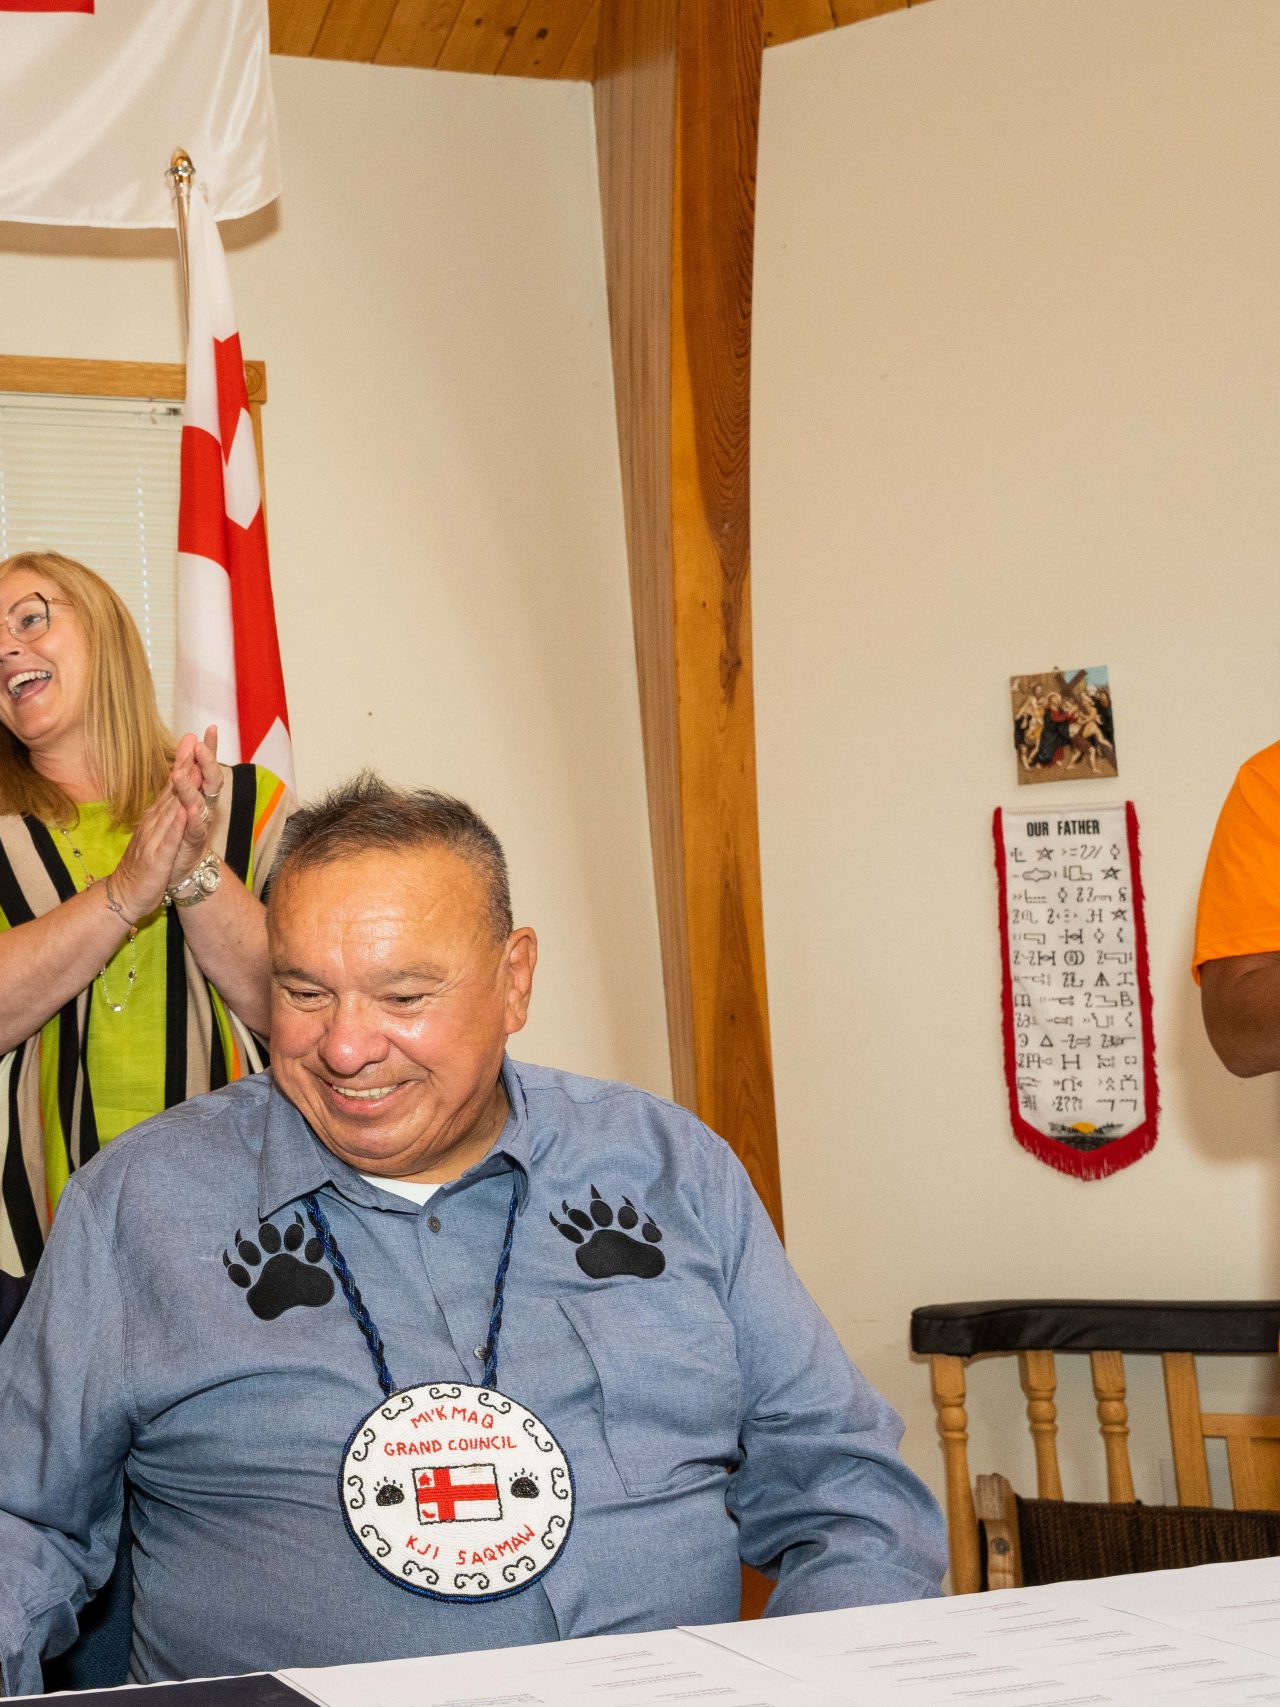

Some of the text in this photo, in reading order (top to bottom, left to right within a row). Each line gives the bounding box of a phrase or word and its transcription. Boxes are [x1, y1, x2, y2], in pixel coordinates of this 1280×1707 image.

[1026, 819, 1101, 837] OUR FATHER
[384, 1435, 517, 1457] GRAND COUNCIL
[405, 1524, 536, 1566] KJI SAQMAW
